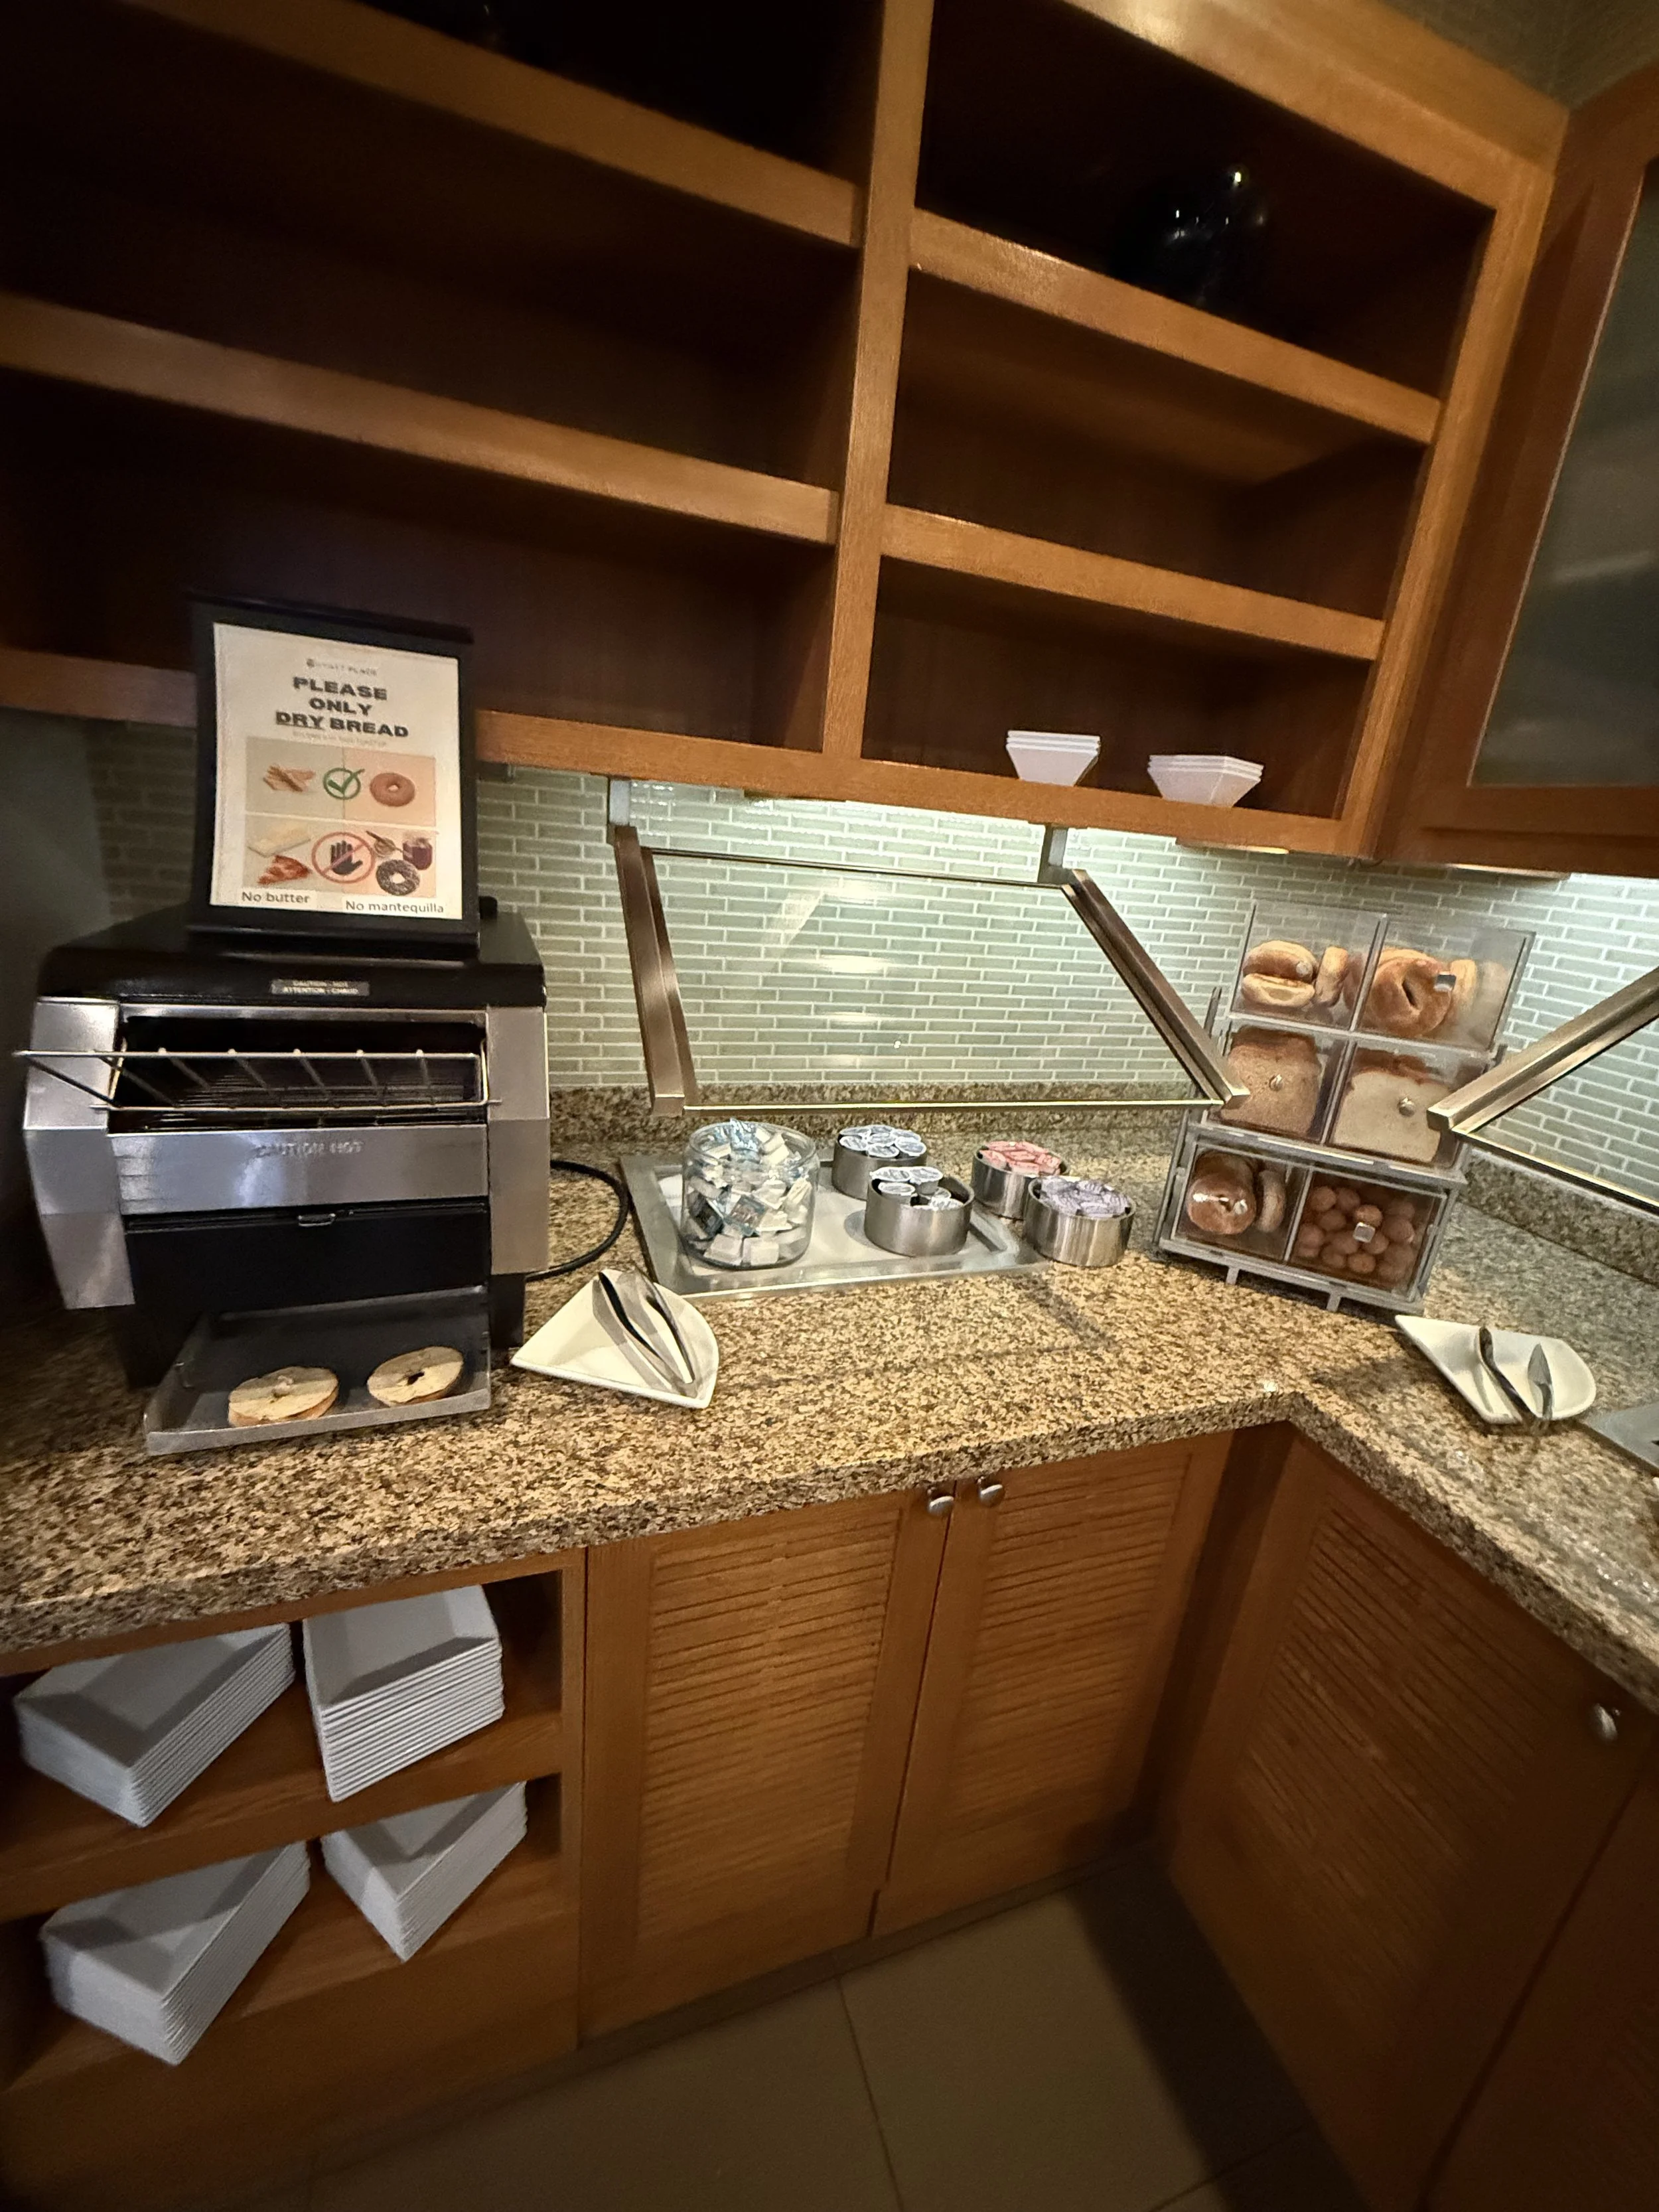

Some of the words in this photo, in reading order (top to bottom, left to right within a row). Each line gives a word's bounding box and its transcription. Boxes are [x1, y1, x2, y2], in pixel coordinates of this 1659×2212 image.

[293, 676, 388, 701] PLEASE
[309, 698, 373, 716] ONLY
[275, 711, 324, 729] DRY
[330, 717, 409, 737] BREAD
[241, 891, 261, 903] No
[266, 893, 311, 904] butter
[345, 900, 364, 911] No
[369, 901, 444, 914] mantequilla
